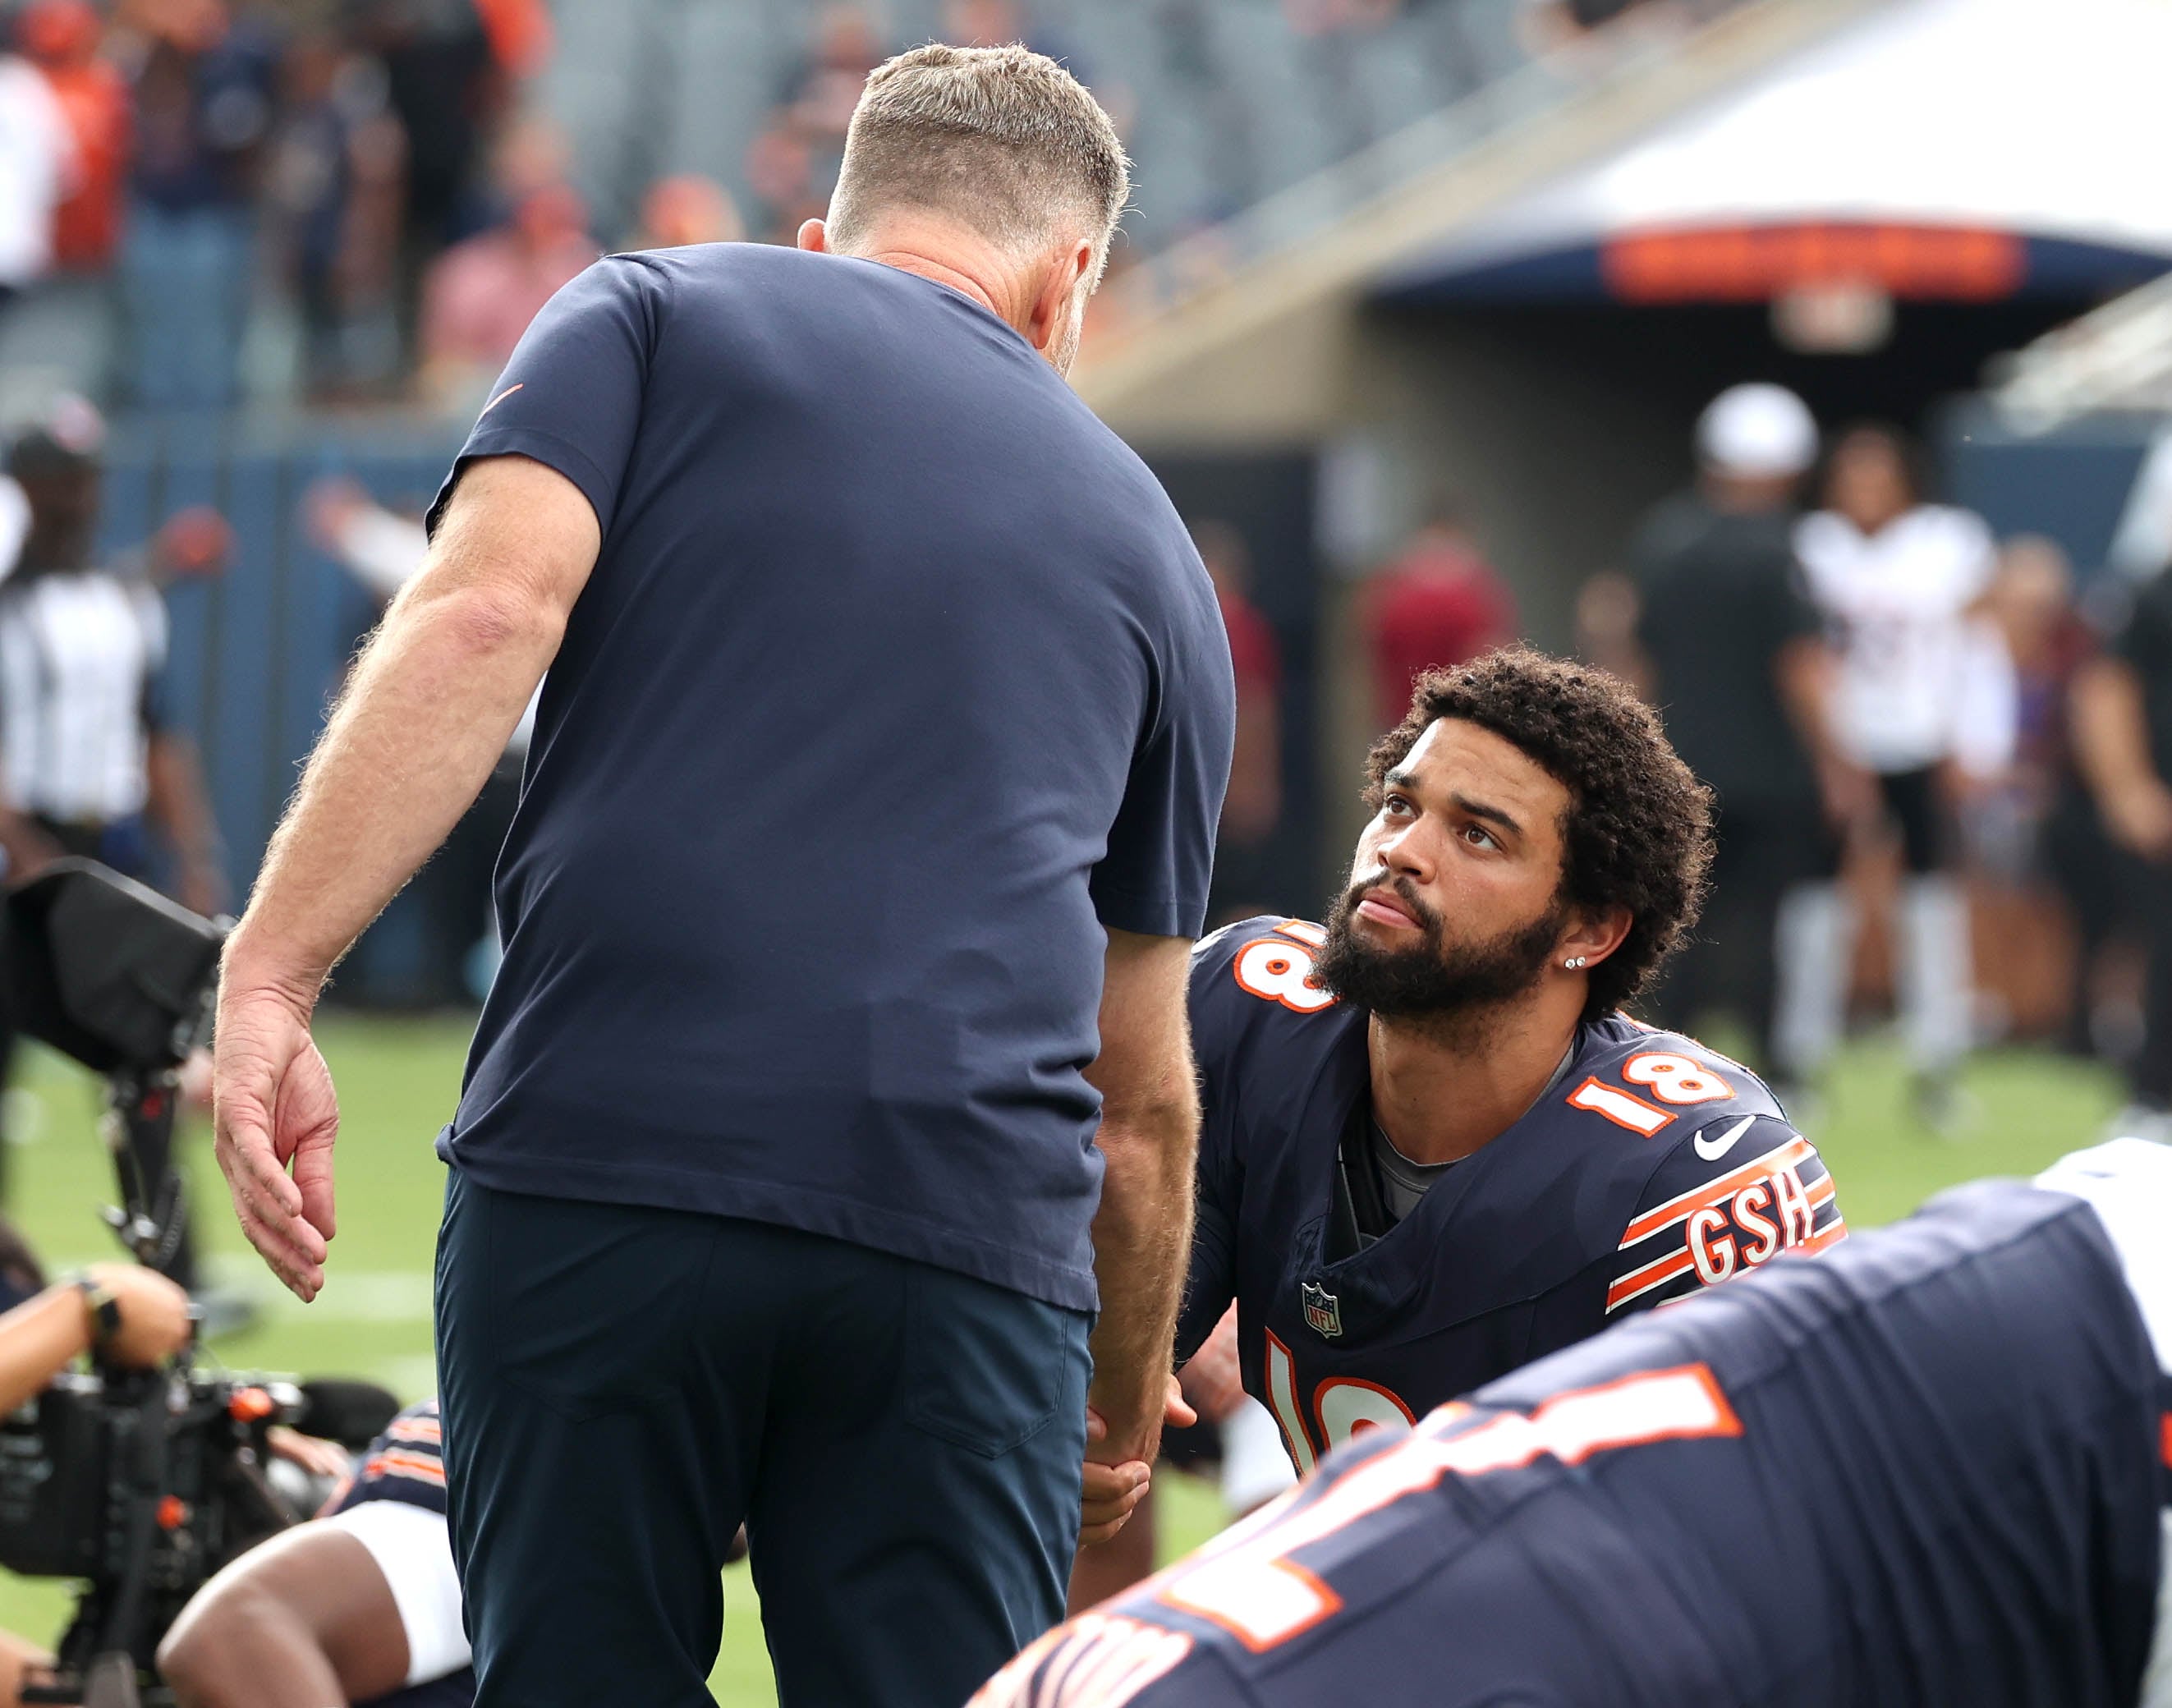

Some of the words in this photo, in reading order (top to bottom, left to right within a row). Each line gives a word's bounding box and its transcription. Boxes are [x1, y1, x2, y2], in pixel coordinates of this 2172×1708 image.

[1565, 1051, 1736, 1139] 18
[1686, 1169, 1816, 1287] GSH
[1308, 1306, 1337, 1330] NFL
